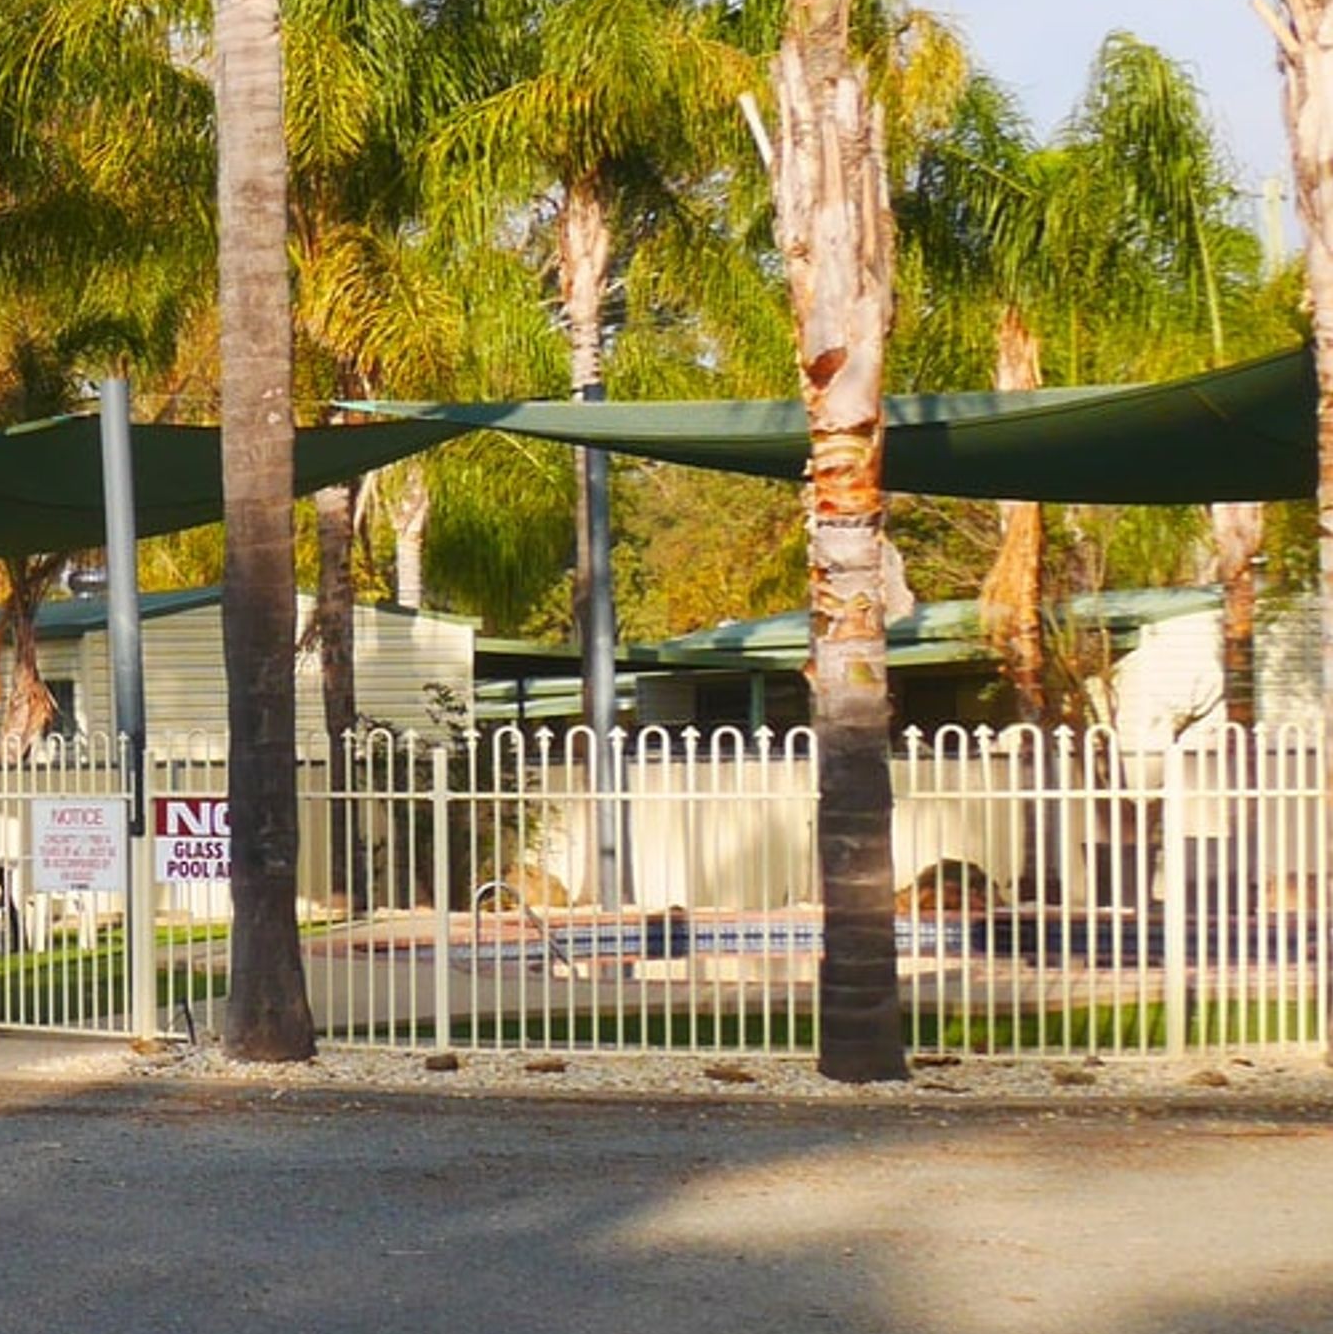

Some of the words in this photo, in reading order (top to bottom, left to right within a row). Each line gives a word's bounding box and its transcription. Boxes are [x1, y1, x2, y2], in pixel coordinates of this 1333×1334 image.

[52, 807, 103, 824] NOTICE
[174, 841, 223, 859] GLASS
[166, 861, 210, 878] POOL
